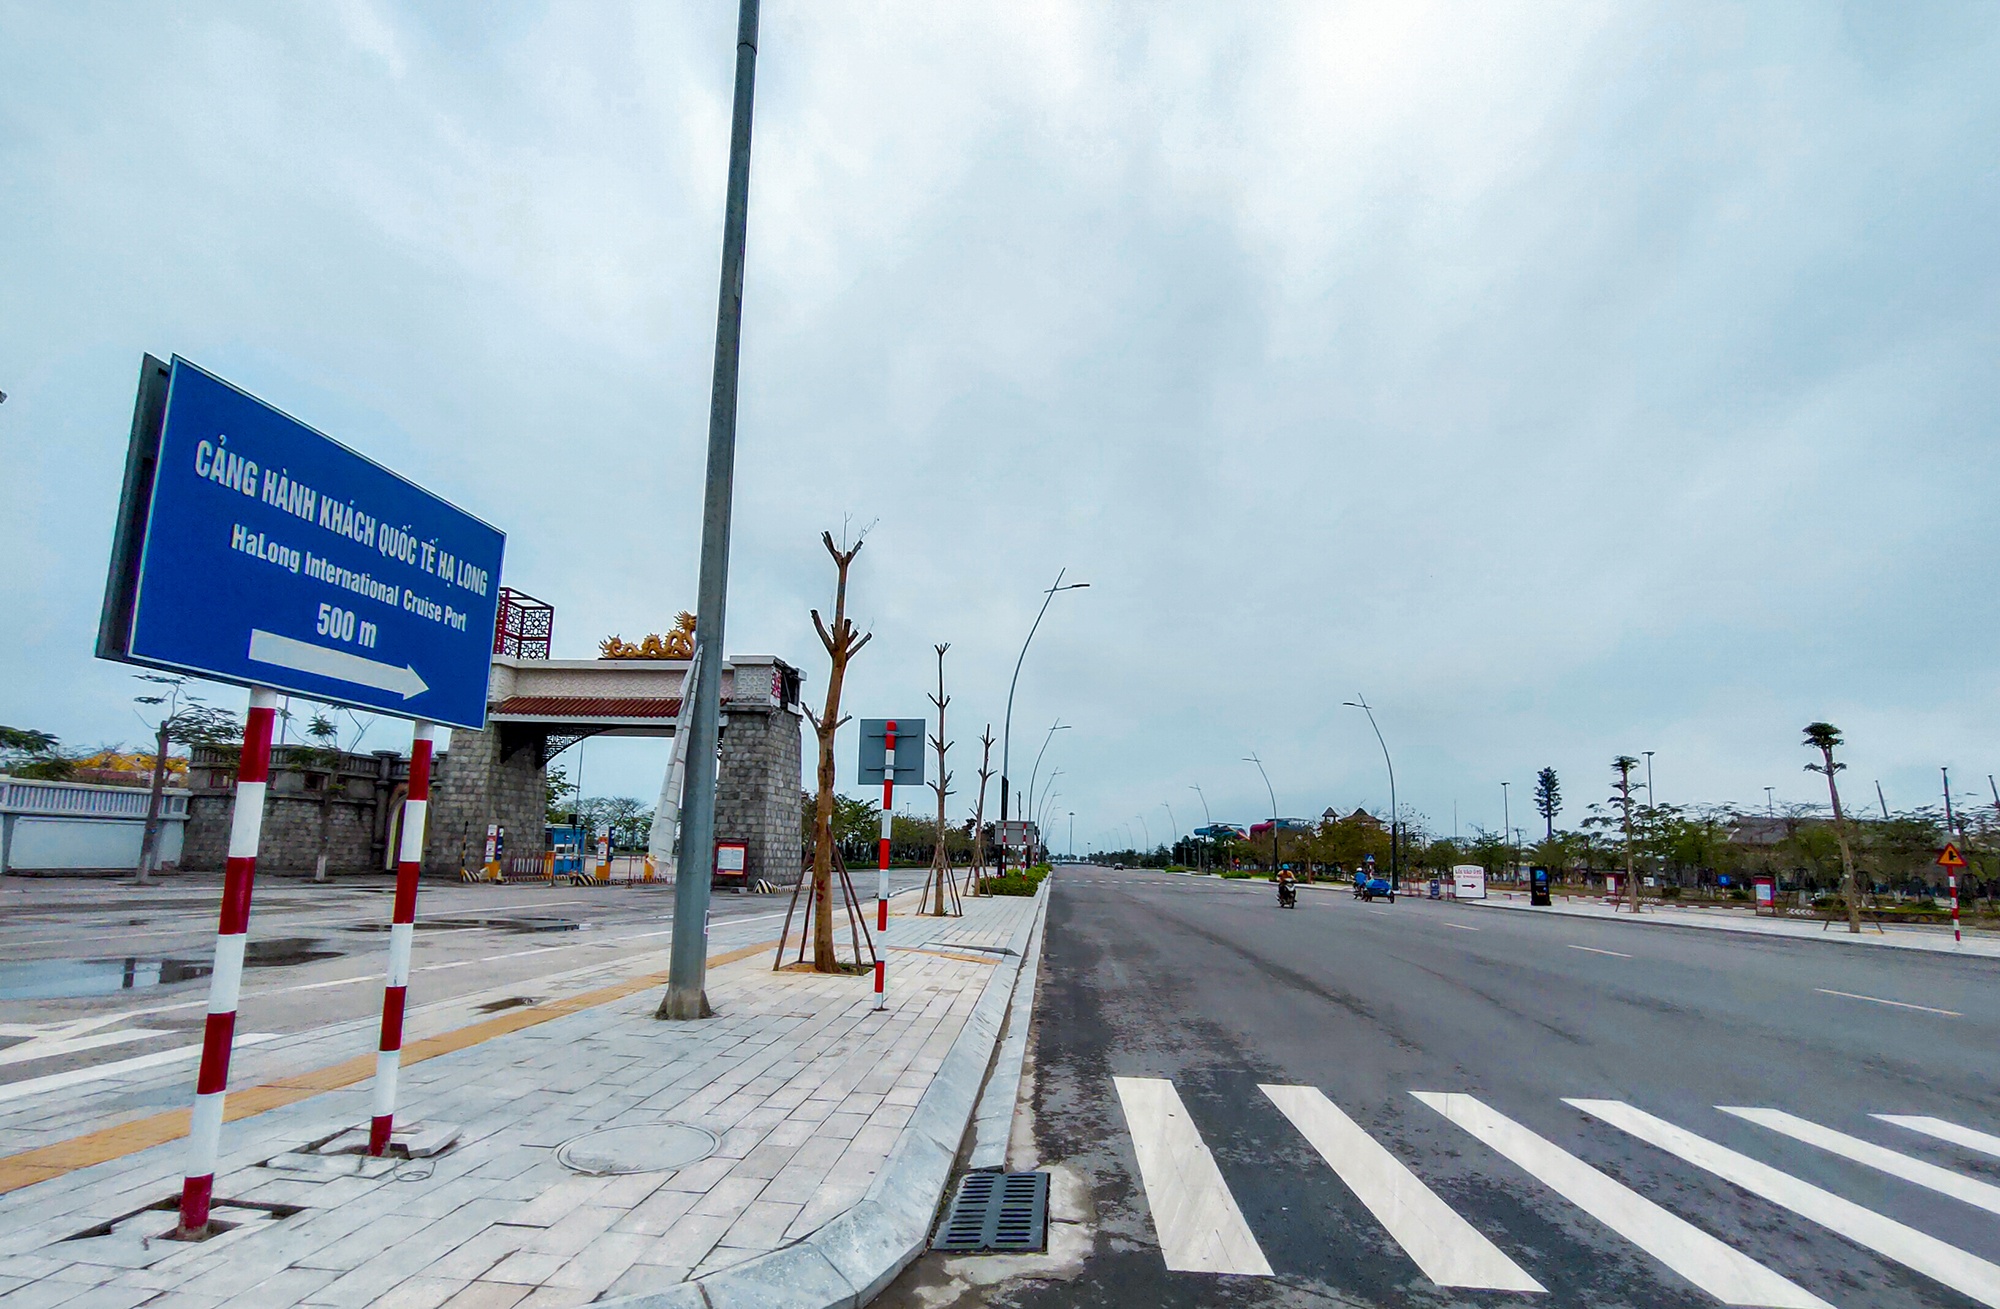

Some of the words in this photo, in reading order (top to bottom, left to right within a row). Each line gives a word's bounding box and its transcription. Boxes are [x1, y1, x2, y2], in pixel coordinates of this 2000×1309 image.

[195, 434, 258, 497] CẢNG
[262, 468, 317, 522] HÀNH
[319, 495, 376, 548] KHÁCH
[378, 524, 418, 565] QUỐC
[420, 538, 439, 574] TẾ
[437, 550, 455, 588] HẠ
[457, 559, 489, 597] LONG
[231, 523, 300, 574] HaLong
[304, 551, 400, 606] International
[403, 589, 442, 623] Cruise
[444, 605, 467, 632] Port
[317, 602, 355, 642] 500
[358, 620, 377, 648] m
